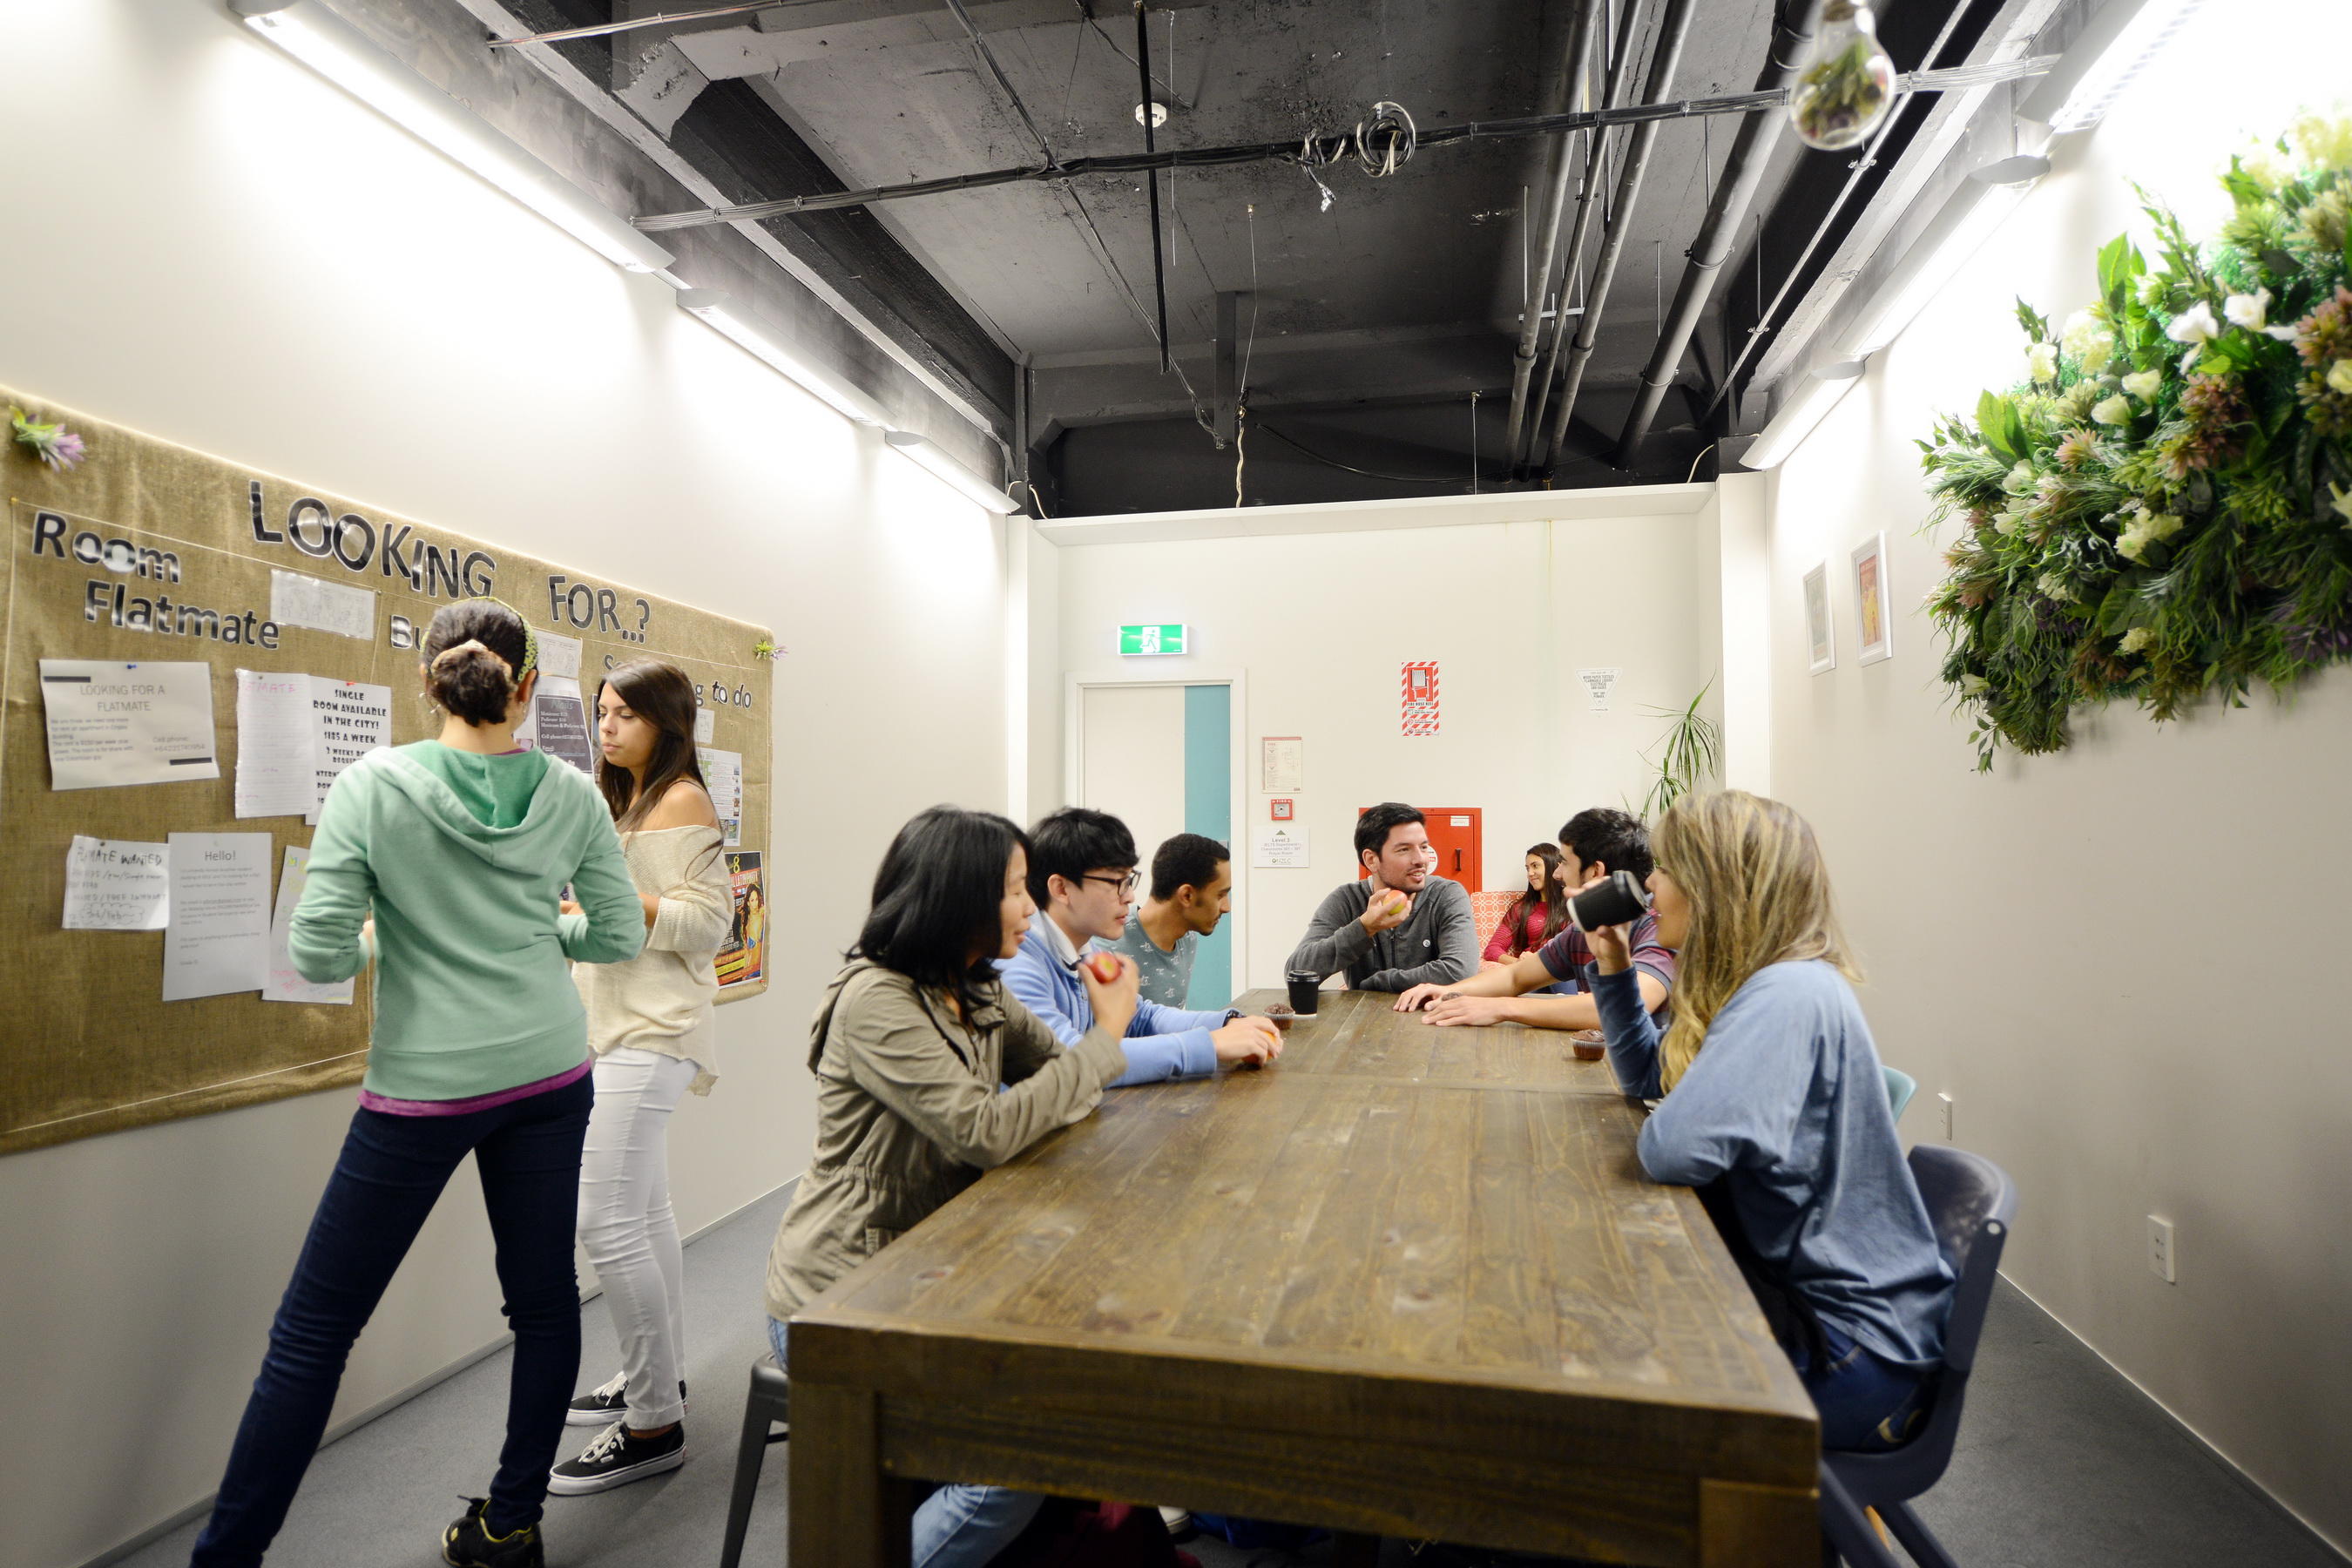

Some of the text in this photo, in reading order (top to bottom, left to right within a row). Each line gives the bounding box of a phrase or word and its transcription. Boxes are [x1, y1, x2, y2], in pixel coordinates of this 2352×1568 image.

[249, 479, 497, 598] LOOKING
[32, 510, 181, 584] Room
[84, 579, 280, 650] Flatmate
[80, 685, 166, 696] LOOKING FOR A
[335, 689, 365, 701] SINGLE
[712, 680, 729, 705] to
[733, 684, 753, 710] do
[97, 700, 152, 713] FLATMATE
[313, 700, 387, 717] ROOM AVAILABLE
[323, 715, 380, 730] IN THE CITY!
[342, 733, 348, 741] A
[351, 733, 376, 744] WEEK
[121, 854, 163, 866] WANTED
[205, 850, 236, 862] Hello!
